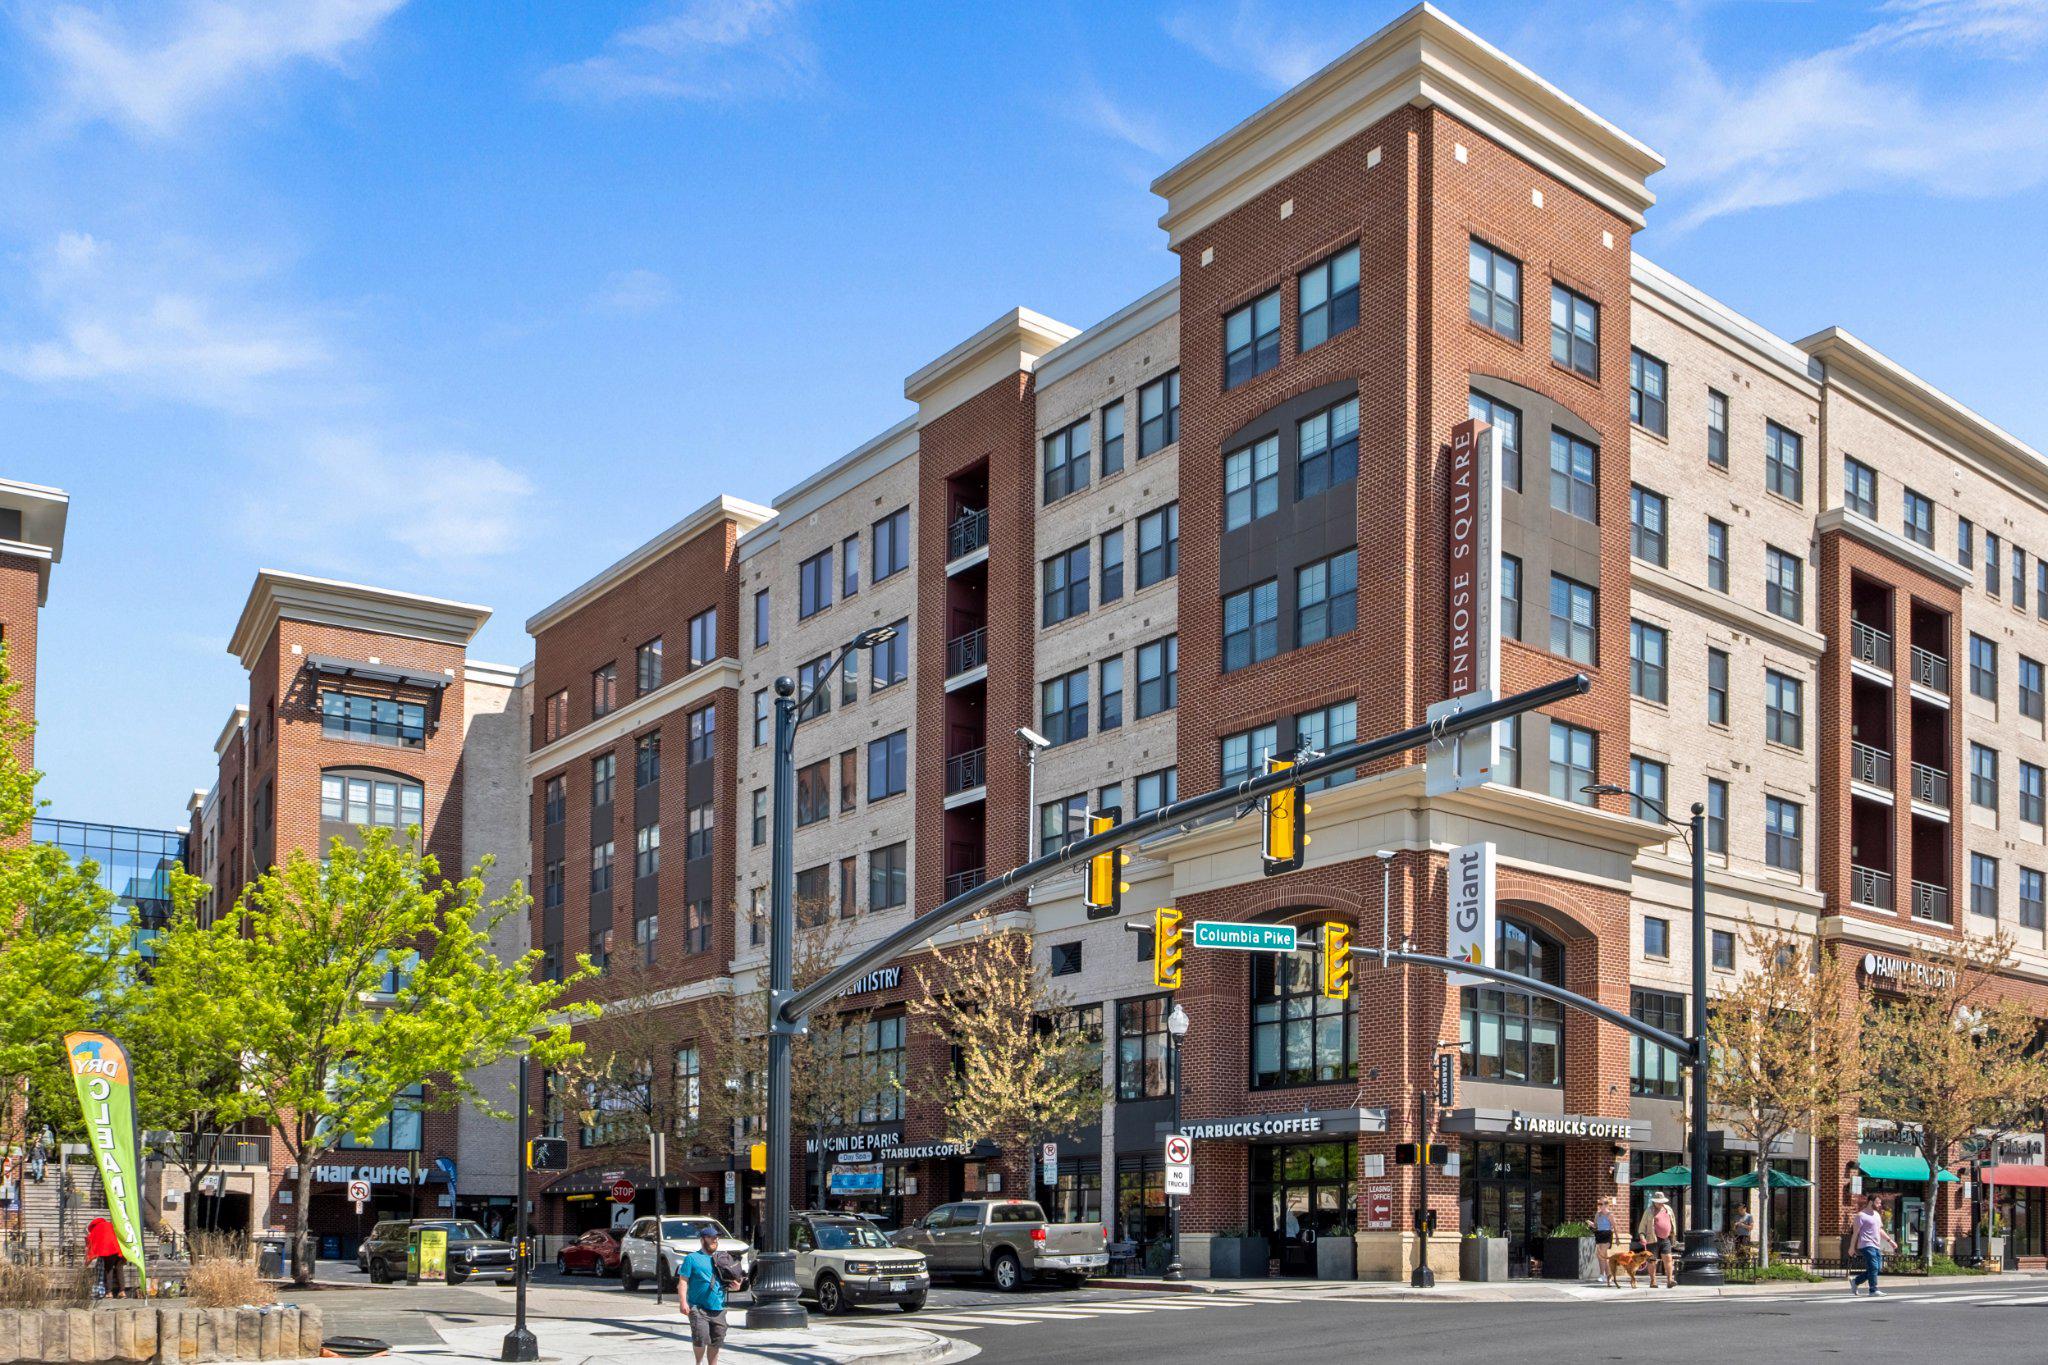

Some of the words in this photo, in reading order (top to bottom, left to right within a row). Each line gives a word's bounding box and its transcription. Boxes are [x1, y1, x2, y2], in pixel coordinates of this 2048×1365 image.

[1454, 431, 1470, 559] SQUARE
[1453, 572, 1469, 693] ENROSE
[1456, 851, 1479, 933] Giant
[1200, 928, 1260, 943] Columbia
[1264, 931, 1291, 945] Pike
[1180, 1122, 1260, 1138] STARBUCKS
[1262, 1117, 1321, 1135] COFFEE
[1514, 1117, 1586, 1135] STARBUCKS
[1589, 1123, 1631, 1139] COFFEE
[851, 1135, 864, 1150] DE
[867, 1132, 899, 1148] PARIS
[880, 1146, 933, 1160] STARBUCKS
[316, 1165, 355, 1182] Hair
[1173, 1171, 1183, 1179] NO
[613, 1187, 634, 1196] STOP
[1370, 1185, 1391, 1193] LEASING
